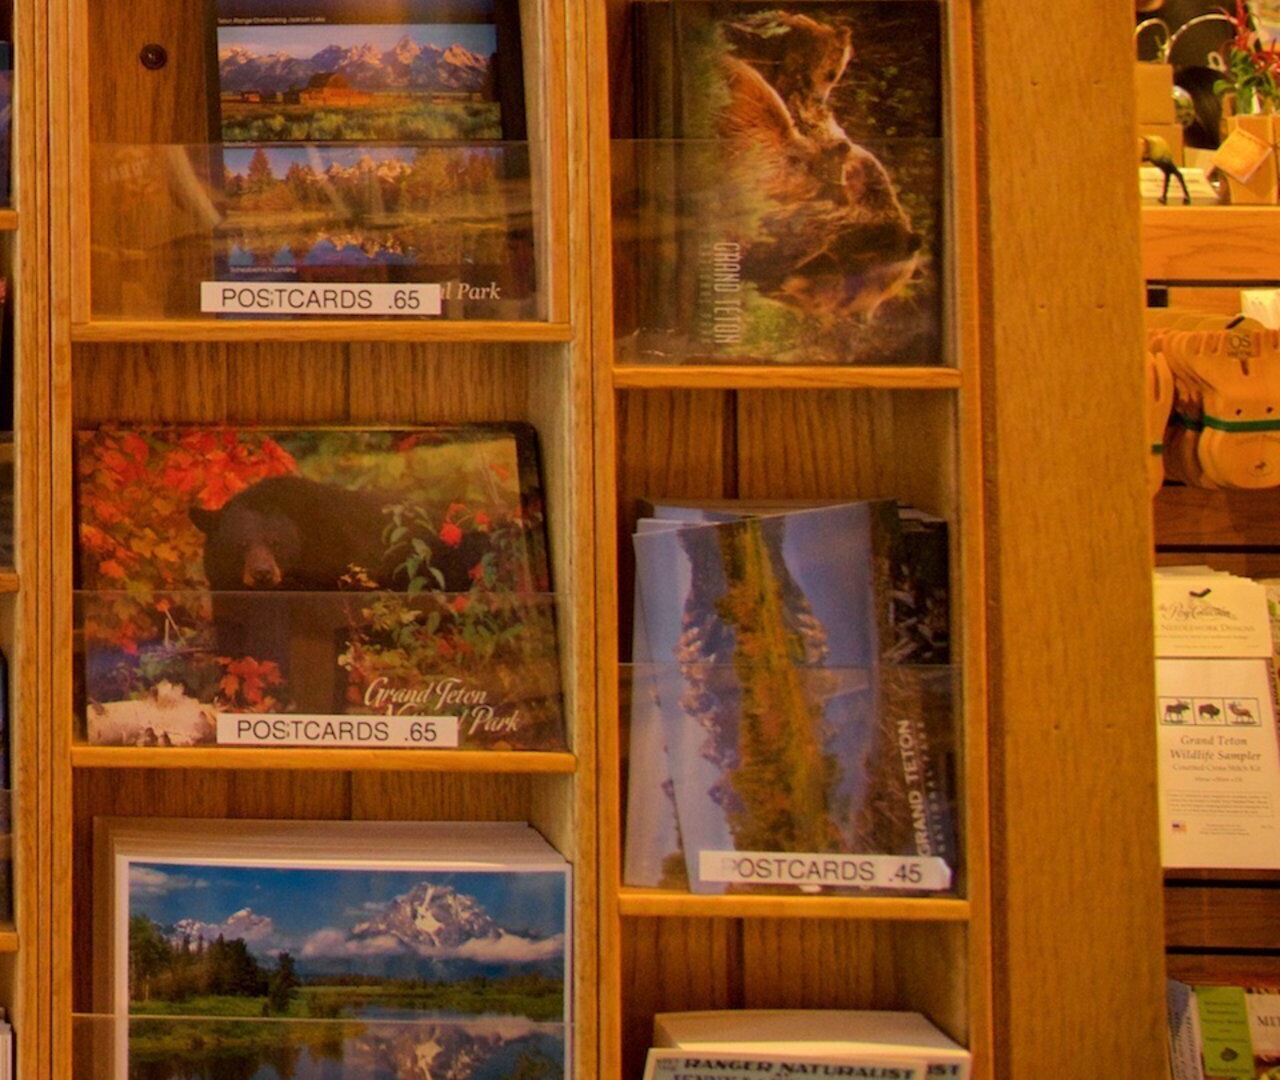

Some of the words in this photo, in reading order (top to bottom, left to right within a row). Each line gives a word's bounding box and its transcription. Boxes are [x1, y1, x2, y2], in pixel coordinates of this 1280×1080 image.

[713, 242, 741, 292] GRAND
[221, 287, 373, 310] POSTCARDS
[388, 289, 420, 310] .65
[458, 281, 502, 301] Park
[713, 300, 742, 344] TETON
[364, 676, 435, 708] Grand
[435, 677, 487, 711] Teton
[238, 720, 389, 742] POSTCARDS
[405, 722, 437, 742] .65
[467, 704, 520, 735] Park
[897, 720, 919, 785] TETON
[1180, 735, 1215, 746] Grand
[1217, 735, 1248, 746] Teton
[1170, 749, 1215, 762] Wildlife
[1217, 750, 1262, 762] Sampler
[908, 790, 932, 857] GRAND
[724, 856, 876, 882] POSTCARDS
[888, 860, 923, 884] .45
[683, 1058, 773, 1072] RANGER
[780, 1061, 915, 1080] NATURALIST
